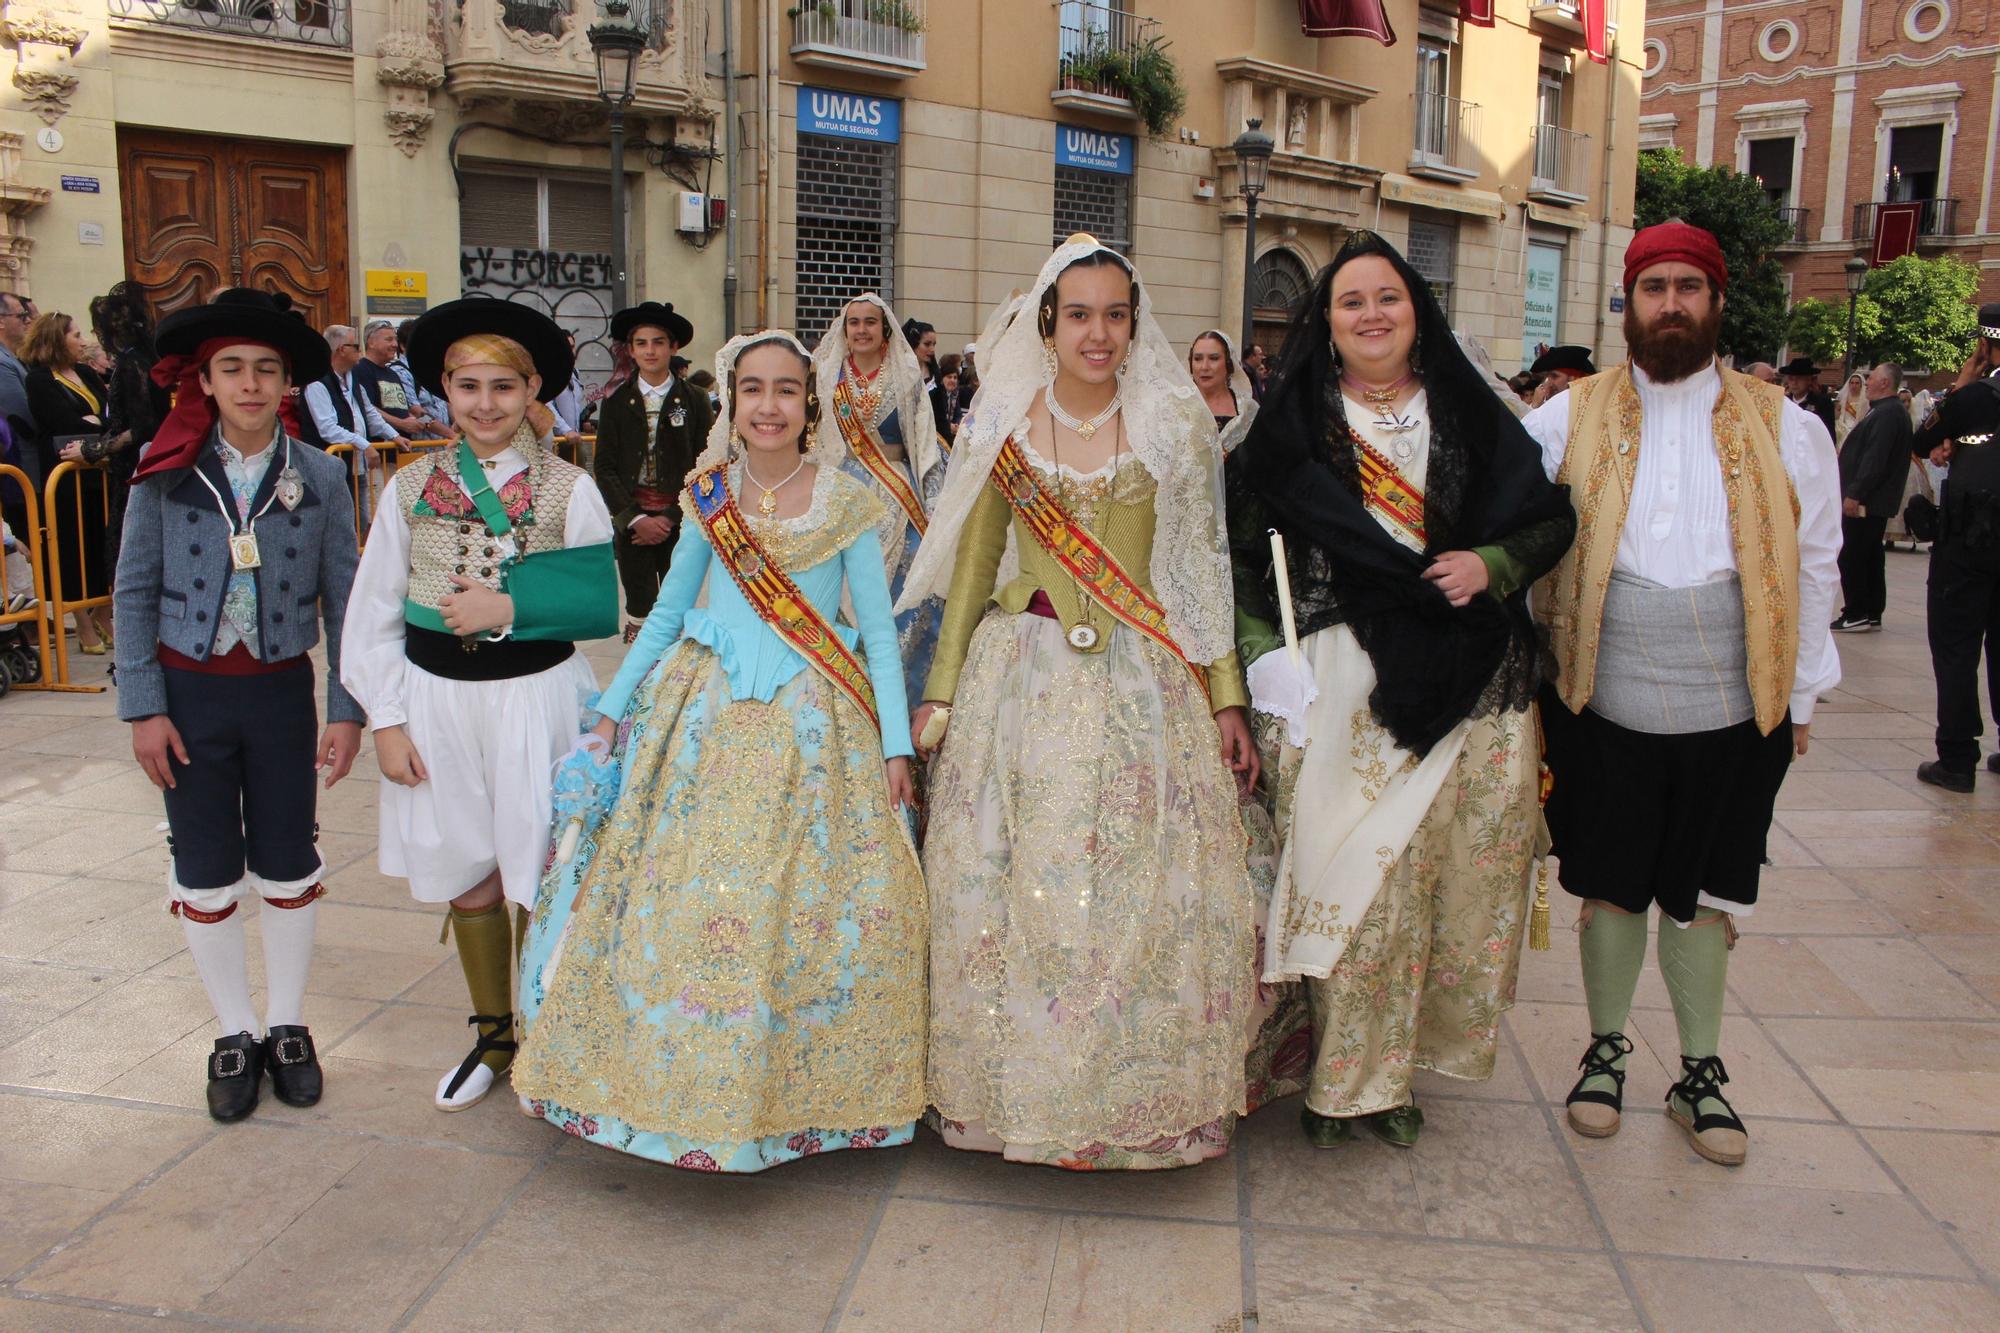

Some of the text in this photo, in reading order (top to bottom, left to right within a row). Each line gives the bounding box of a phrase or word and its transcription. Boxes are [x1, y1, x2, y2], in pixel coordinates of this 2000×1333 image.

[812, 92, 881, 126] UMAS
[815, 121, 879, 136] MUTUA DE SEGUROS
[45, 131, 56, 148] 4
[1066, 130, 1120, 159] UMAS
[1069, 155, 1087, 163] MUTUA
[1094, 158, 1118, 168] SEGUROS
[1524, 301, 1552, 313] Oficina de
[1523, 316, 1552, 328] Atención
